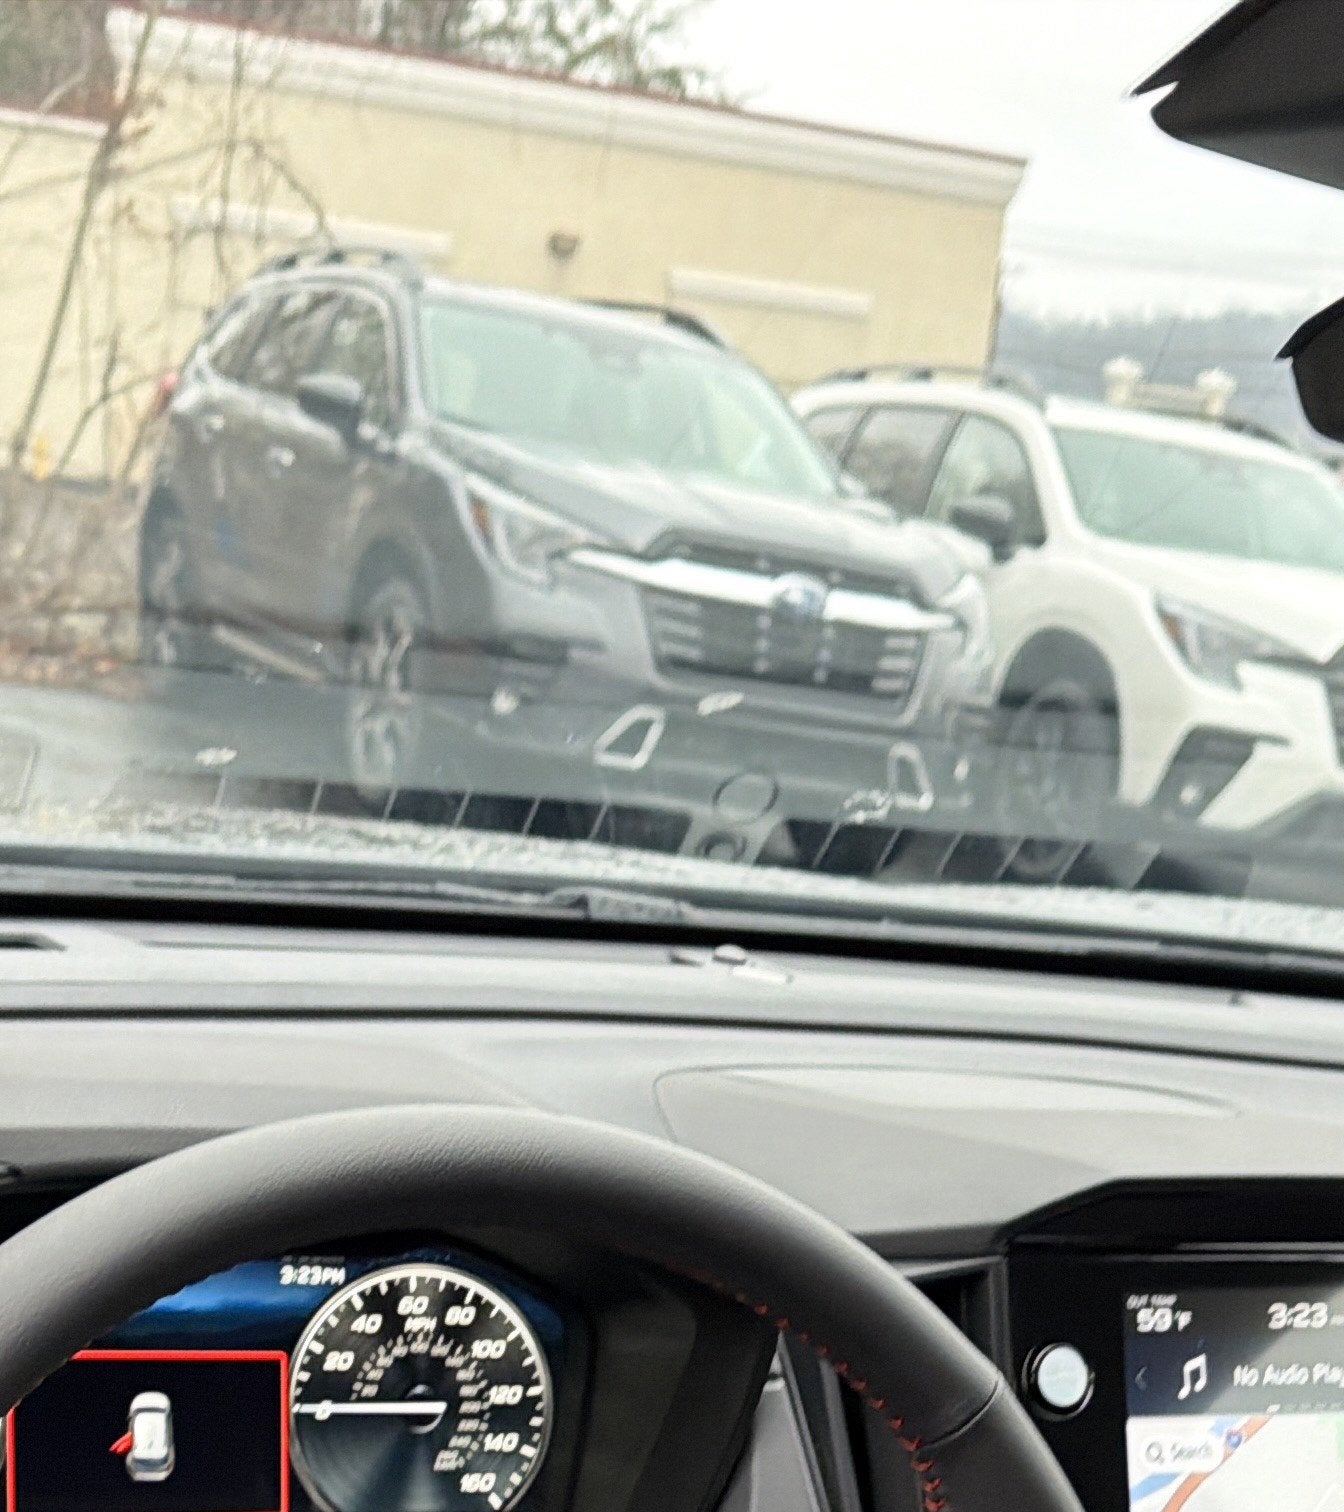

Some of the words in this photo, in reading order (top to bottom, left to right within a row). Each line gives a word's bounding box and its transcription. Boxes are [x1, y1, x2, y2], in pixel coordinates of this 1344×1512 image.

[397, 1296, 429, 1315] 60
[351, 1313, 383, 1334] 40
[444, 1306, 476, 1326] 80
[471, 1339, 506, 1359] 100
[323, 1351, 354, 1371] 20
[1233, 1364, 1258, 1386] No
[1262, 1363, 1307, 1387] Audio
[488, 1384, 523, 1405] 120
[484, 1432, 519, 1452] 140
[460, 1472, 496, 1493] 160
